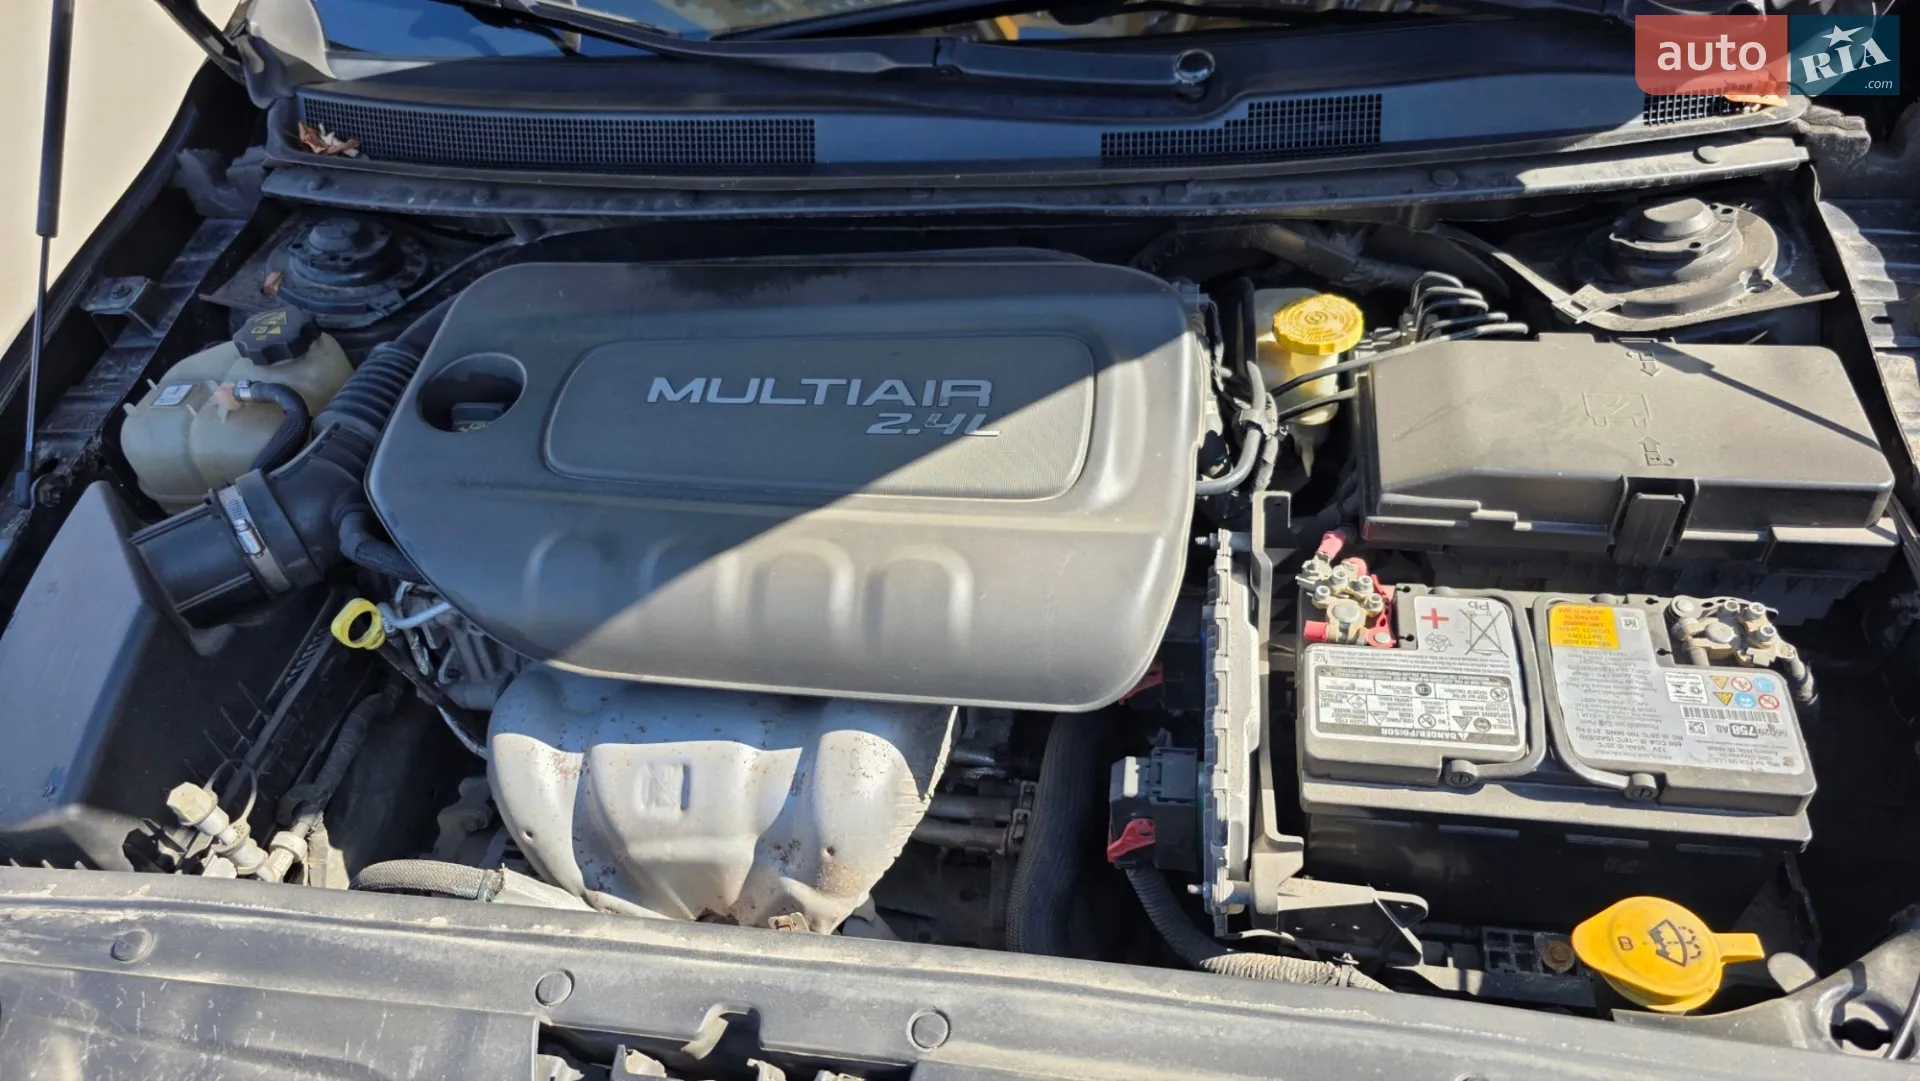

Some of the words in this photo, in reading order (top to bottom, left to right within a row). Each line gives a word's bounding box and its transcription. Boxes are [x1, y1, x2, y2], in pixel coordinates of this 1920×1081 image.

[646, 377, 995, 407] MULTIAIR
[865, 412, 1001, 437] 2.4L
[1468, 600, 1490, 611] Pb
[1381, 728, 1457, 740] DANGER/POISON
